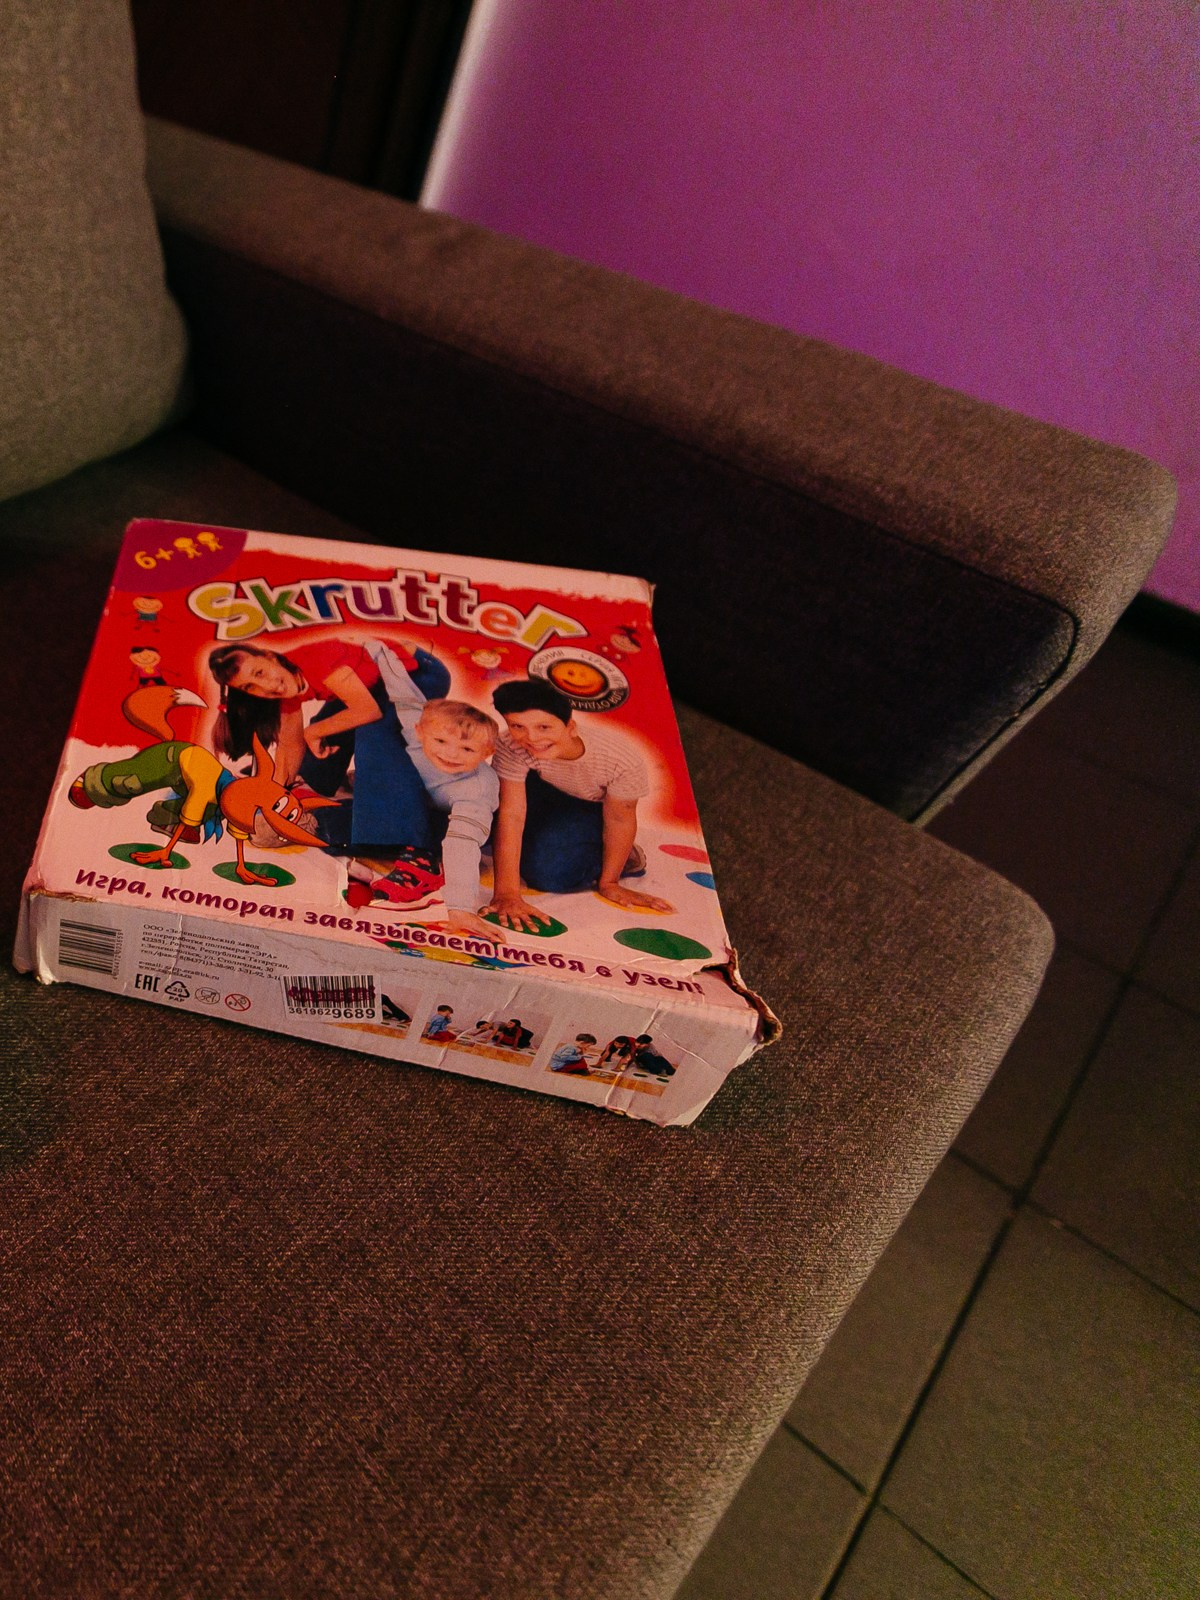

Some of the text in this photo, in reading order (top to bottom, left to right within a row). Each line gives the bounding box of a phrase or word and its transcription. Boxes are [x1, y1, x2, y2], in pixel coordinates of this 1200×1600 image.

[134, 548, 174, 570] 6+
[189, 569, 590, 651] Skrutter
[75, 868, 152, 898] Игра,
[161, 884, 294, 922] которая
[303, 910, 494, 957] завязывает
[501, 944, 586, 975] тебя
[595, 964, 613, 978] в
[142, 923, 164, 932] ООО
[135, 973, 161, 992] EAC
